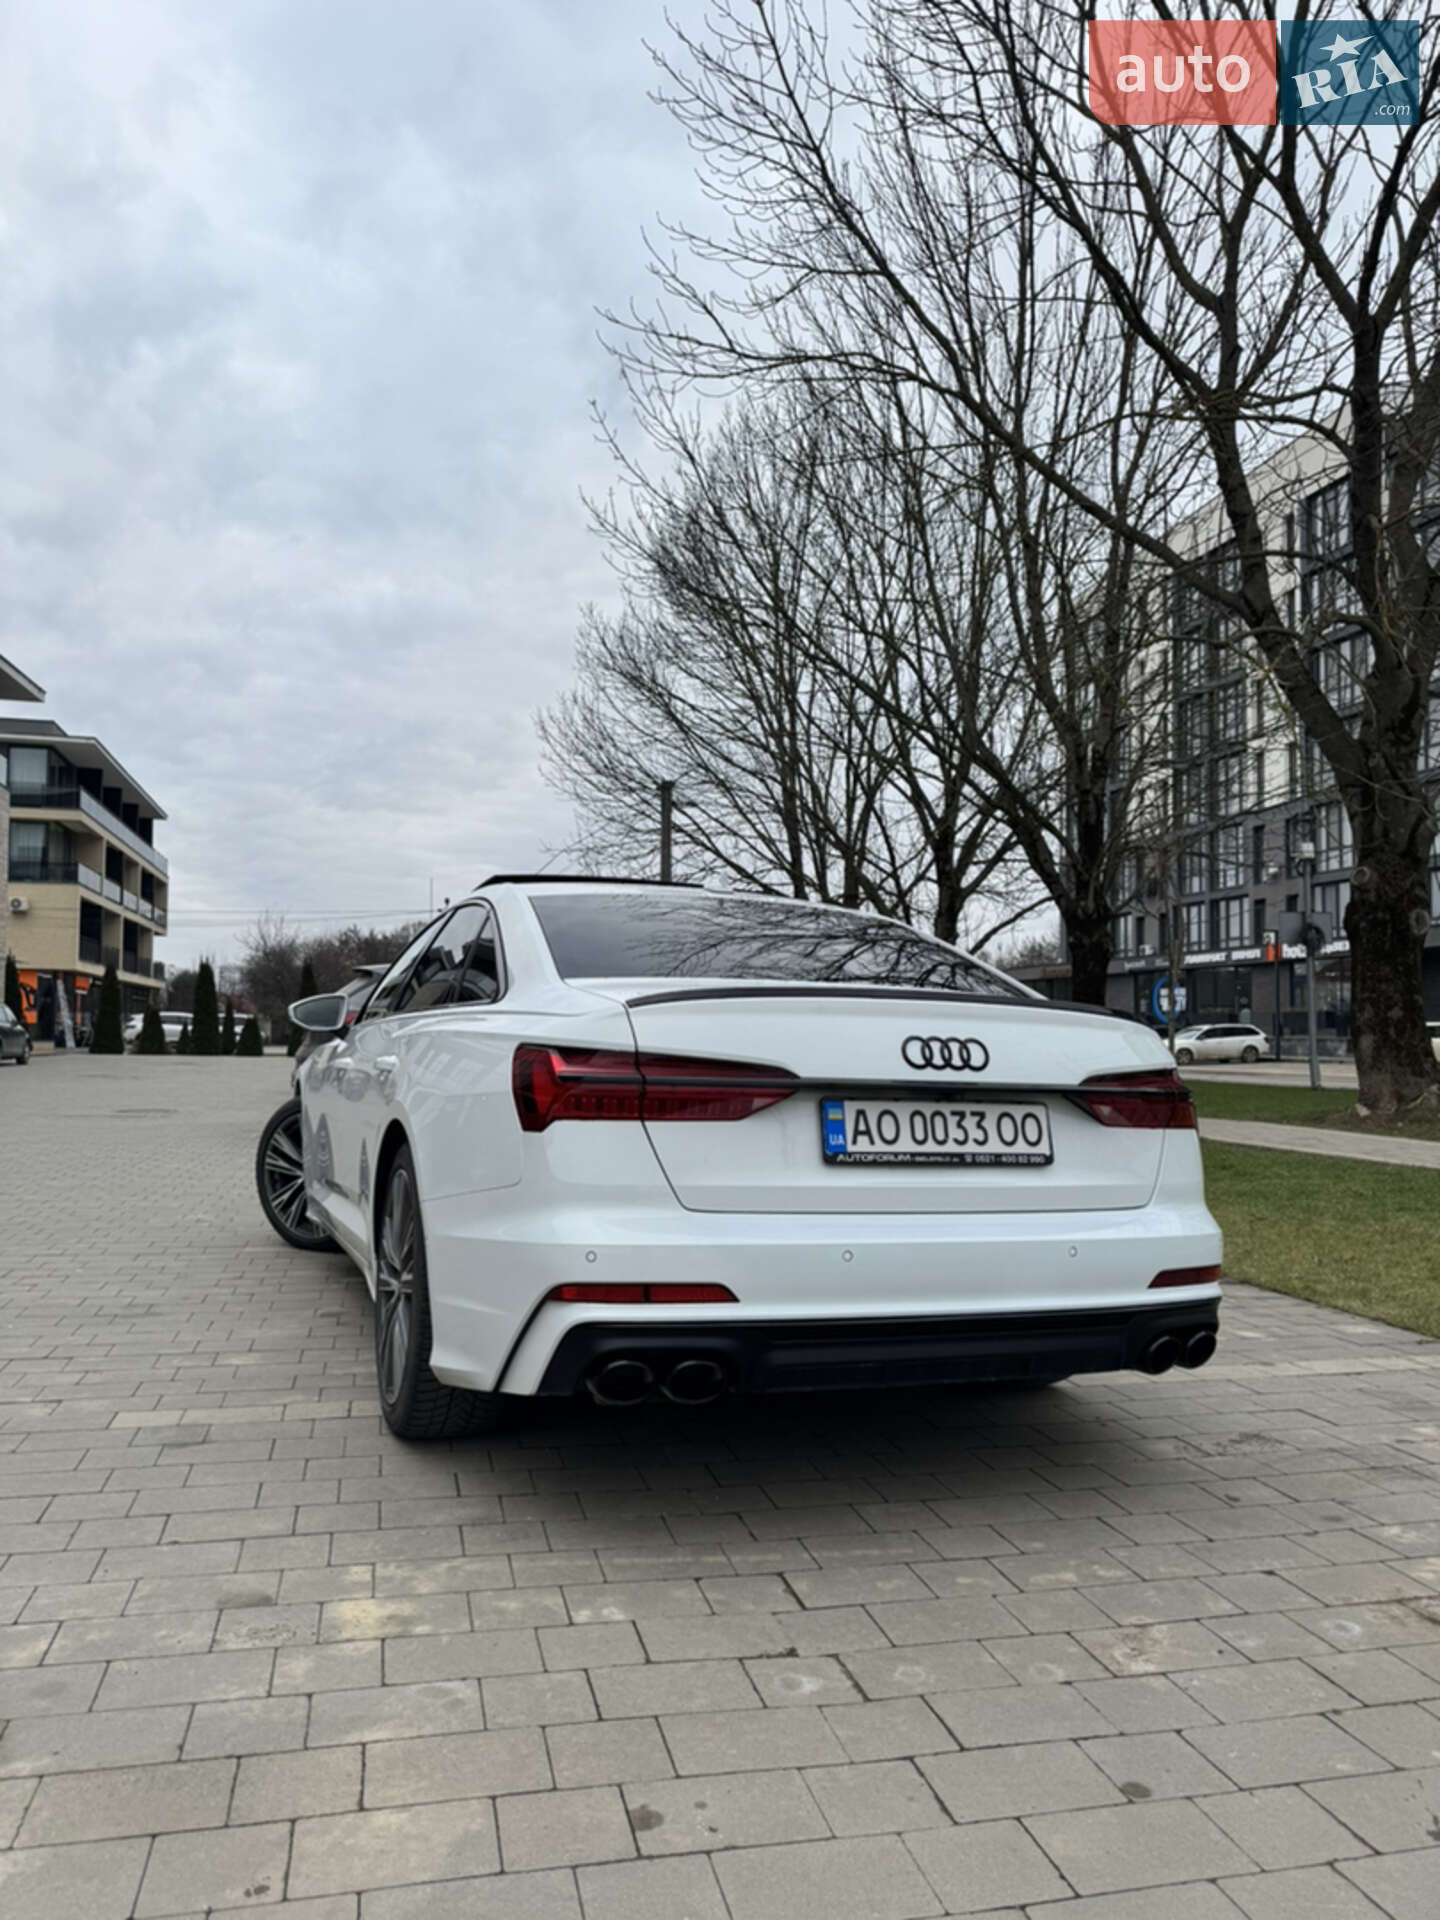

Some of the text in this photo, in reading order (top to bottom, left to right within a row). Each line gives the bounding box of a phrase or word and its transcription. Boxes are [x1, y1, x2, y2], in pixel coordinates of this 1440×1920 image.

[852, 1109, 1043, 1147] AO 0033 OO
[829, 1134, 846, 1145] UA
[836, 1153, 911, 1163] AUTOFORUM
